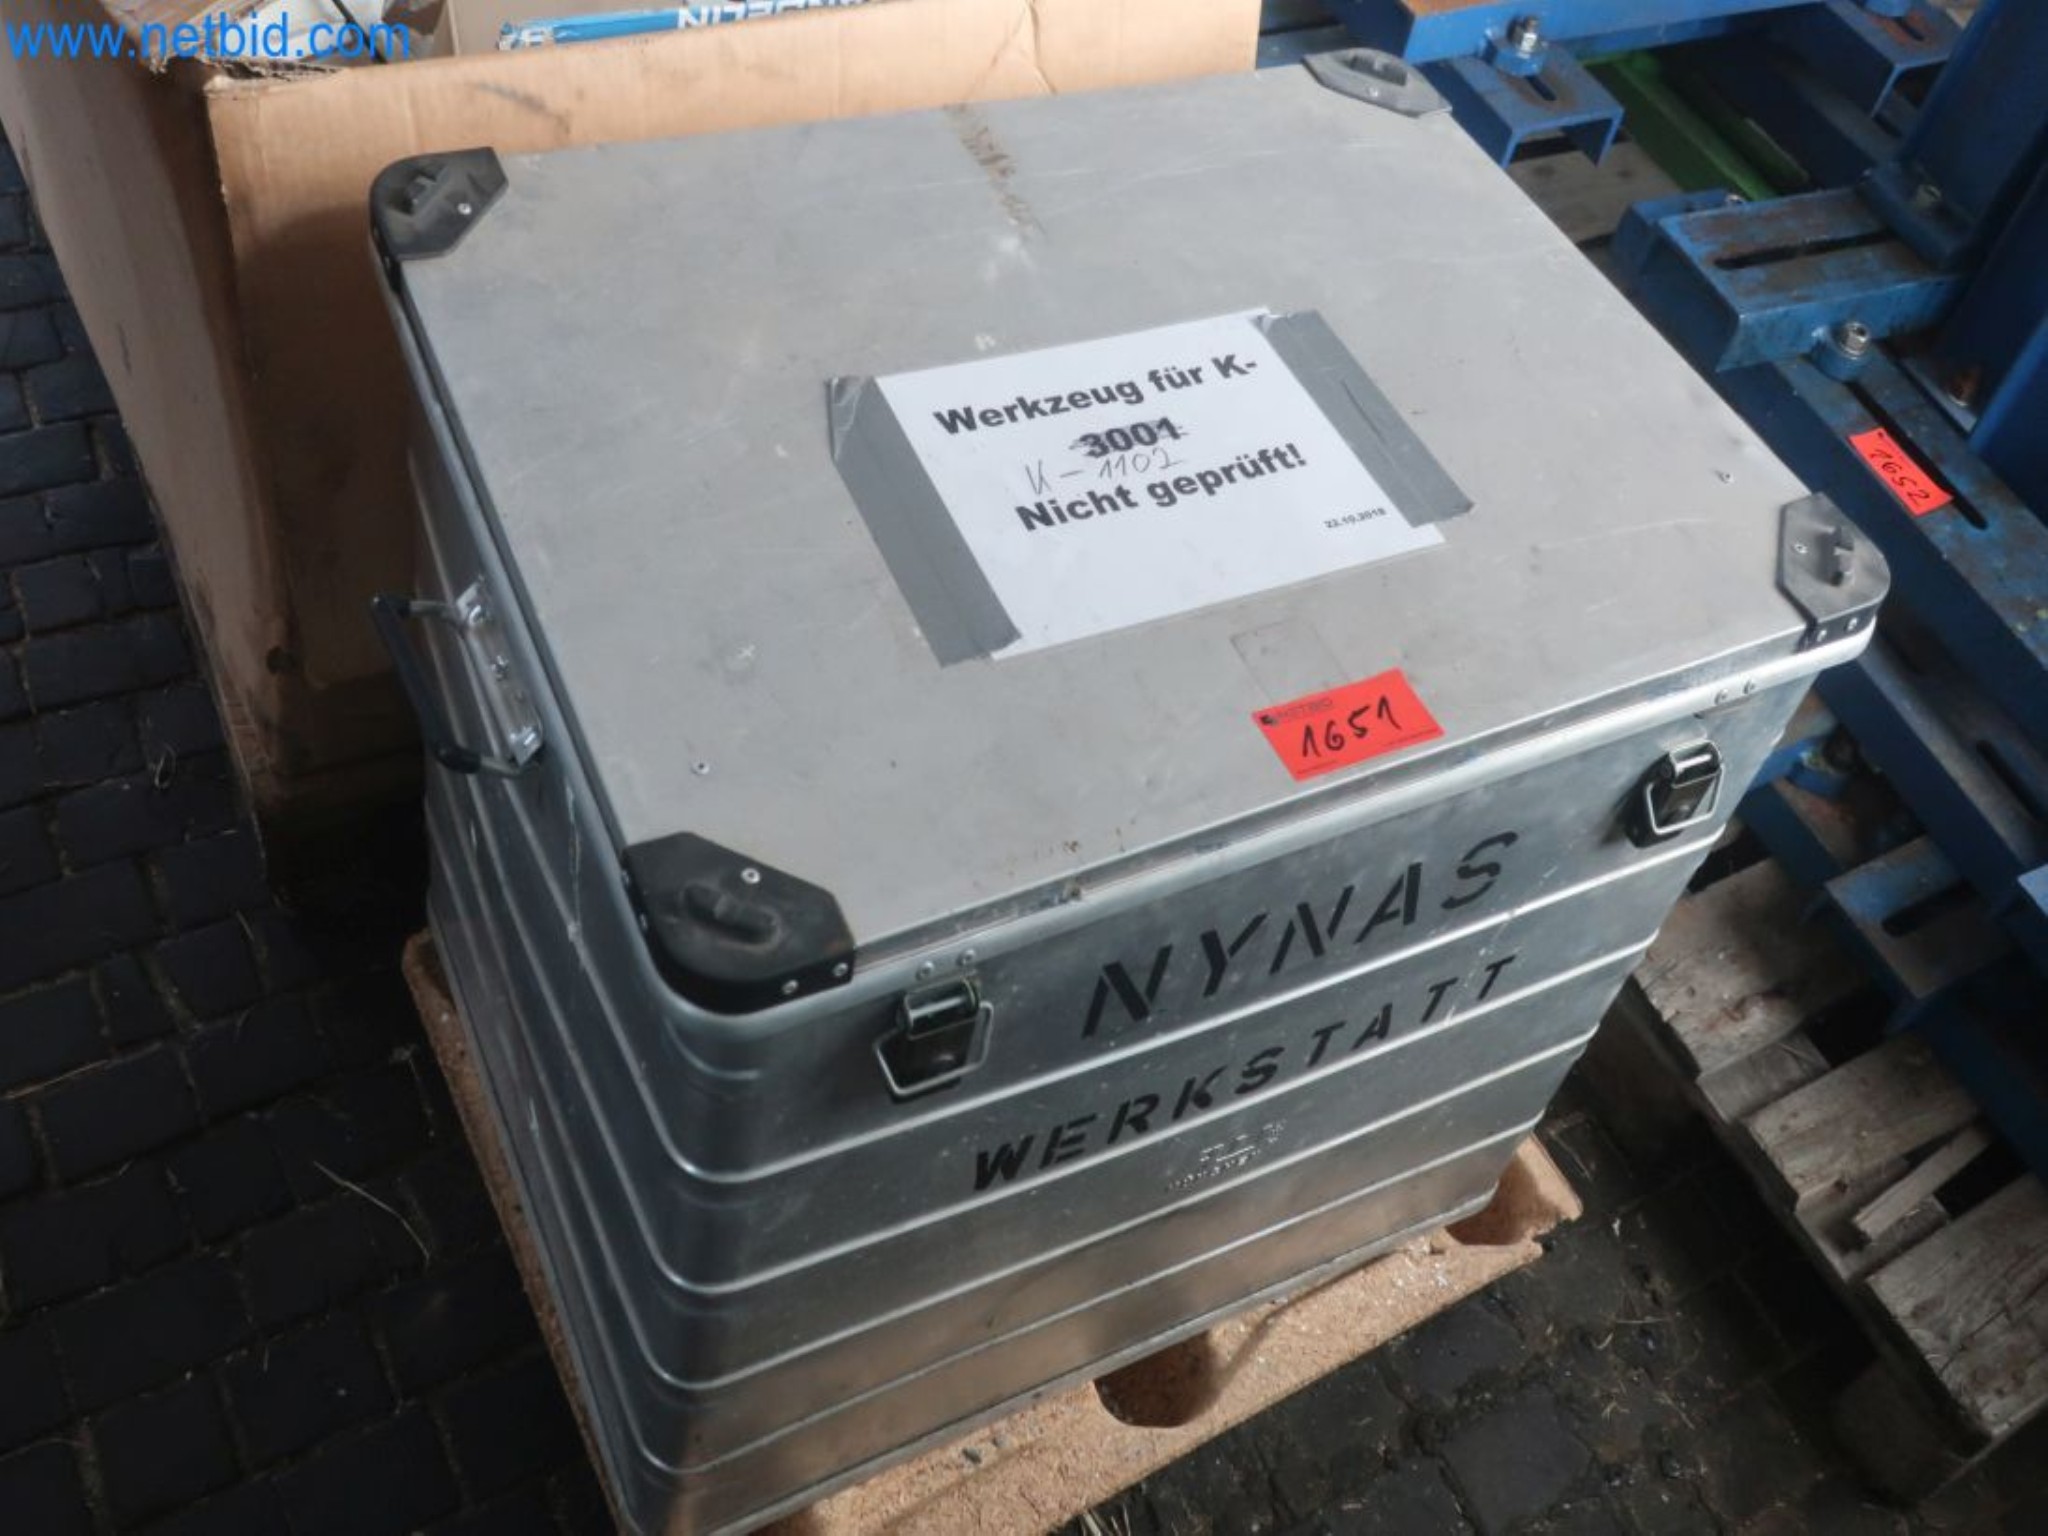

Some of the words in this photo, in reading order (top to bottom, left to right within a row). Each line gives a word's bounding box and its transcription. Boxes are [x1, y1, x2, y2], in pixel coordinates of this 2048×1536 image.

[934, 378, 1144, 435] Werkzeug
[1149, 363, 1204, 393] für
[1212, 354, 1258, 379] K-
[1077, 417, 1183, 458] 3001
[1869, 448, 1931, 508] 1652
[1015, 484, 1139, 532] Nicht
[1146, 441, 1307, 507] geprüft!
[1302, 695, 1402, 757] 1651
[1081, 830, 1520, 1041] NYNAS
[973, 954, 1517, 1191] WERKSTATT
